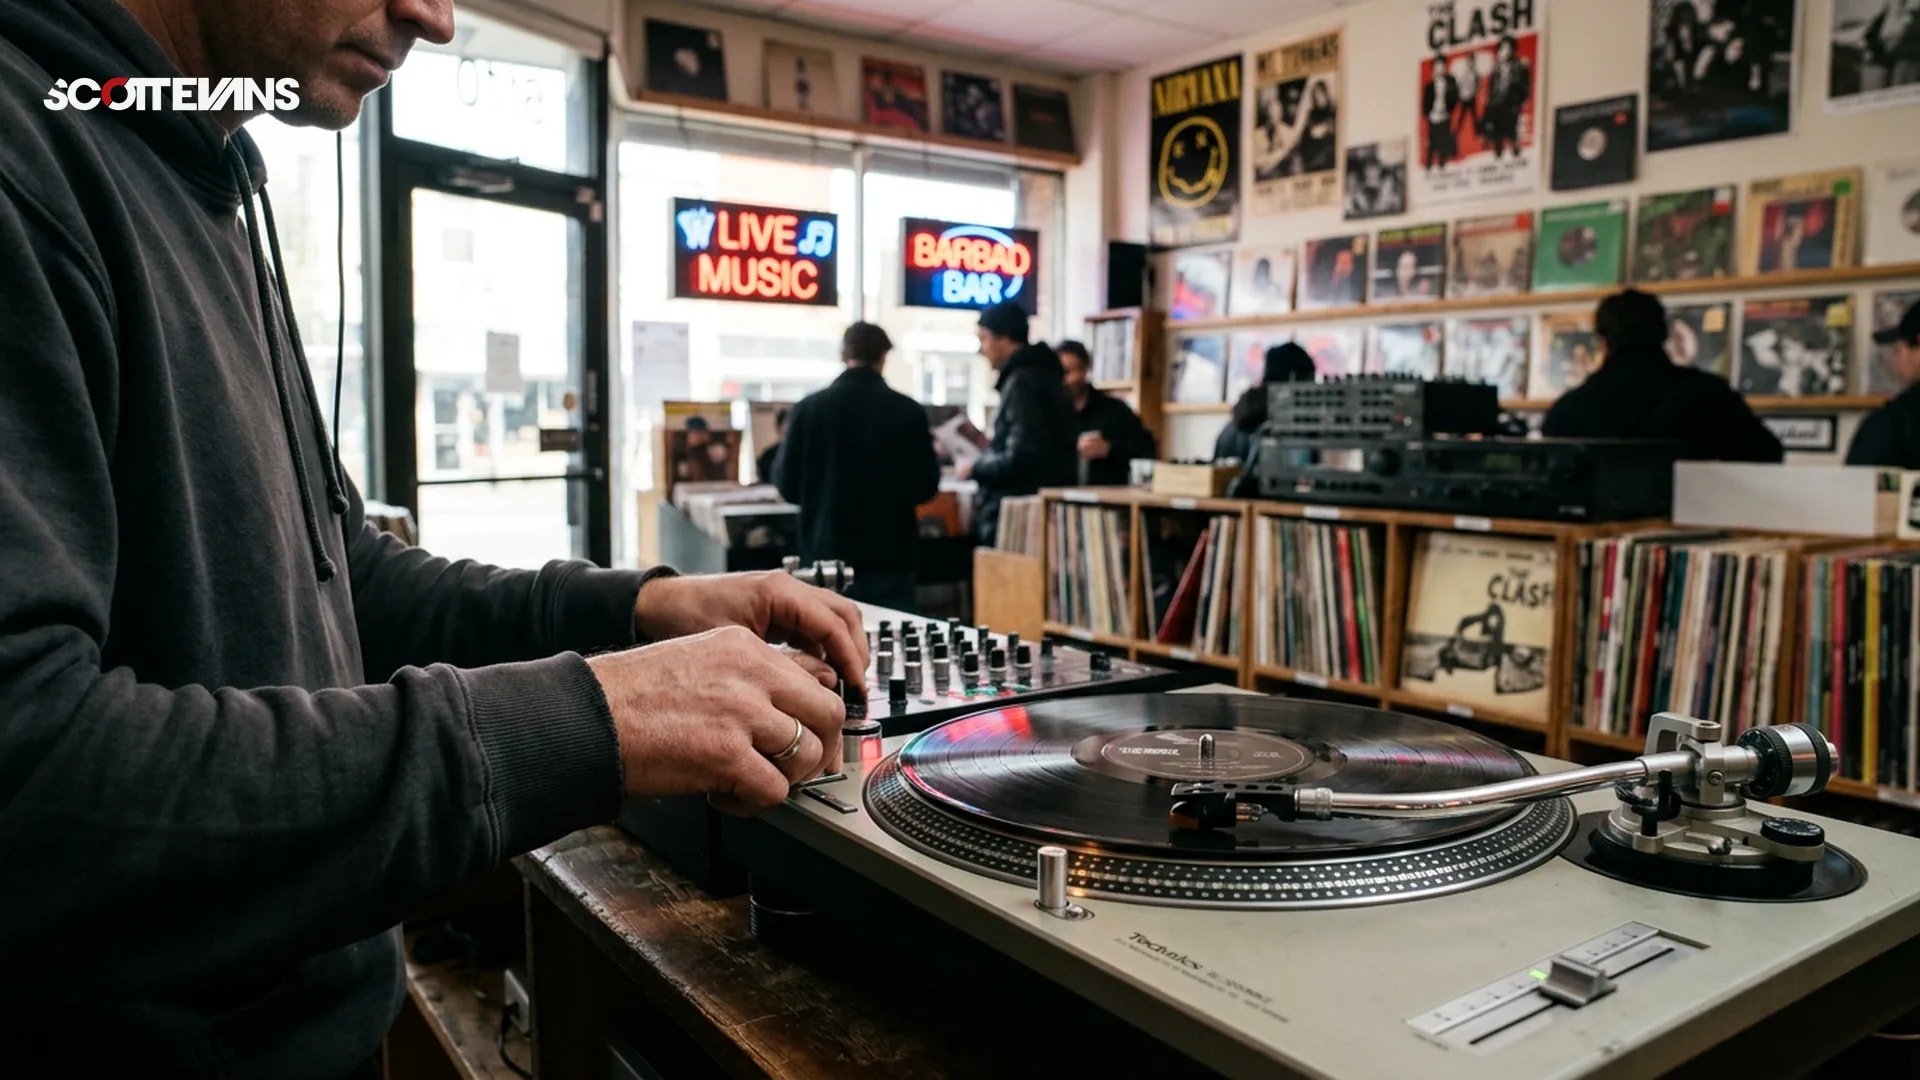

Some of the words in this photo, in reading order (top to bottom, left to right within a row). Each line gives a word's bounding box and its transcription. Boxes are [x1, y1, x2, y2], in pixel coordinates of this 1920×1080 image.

[1428, 0, 1534, 50] CLASH
[1154, 60, 1240, 116] NIRVANA
[717, 209, 799, 256] LIVE
[913, 232, 1031, 276] BARBAD
[697, 253, 819, 300] MUSIC
[942, 269, 1004, 305] BAR
